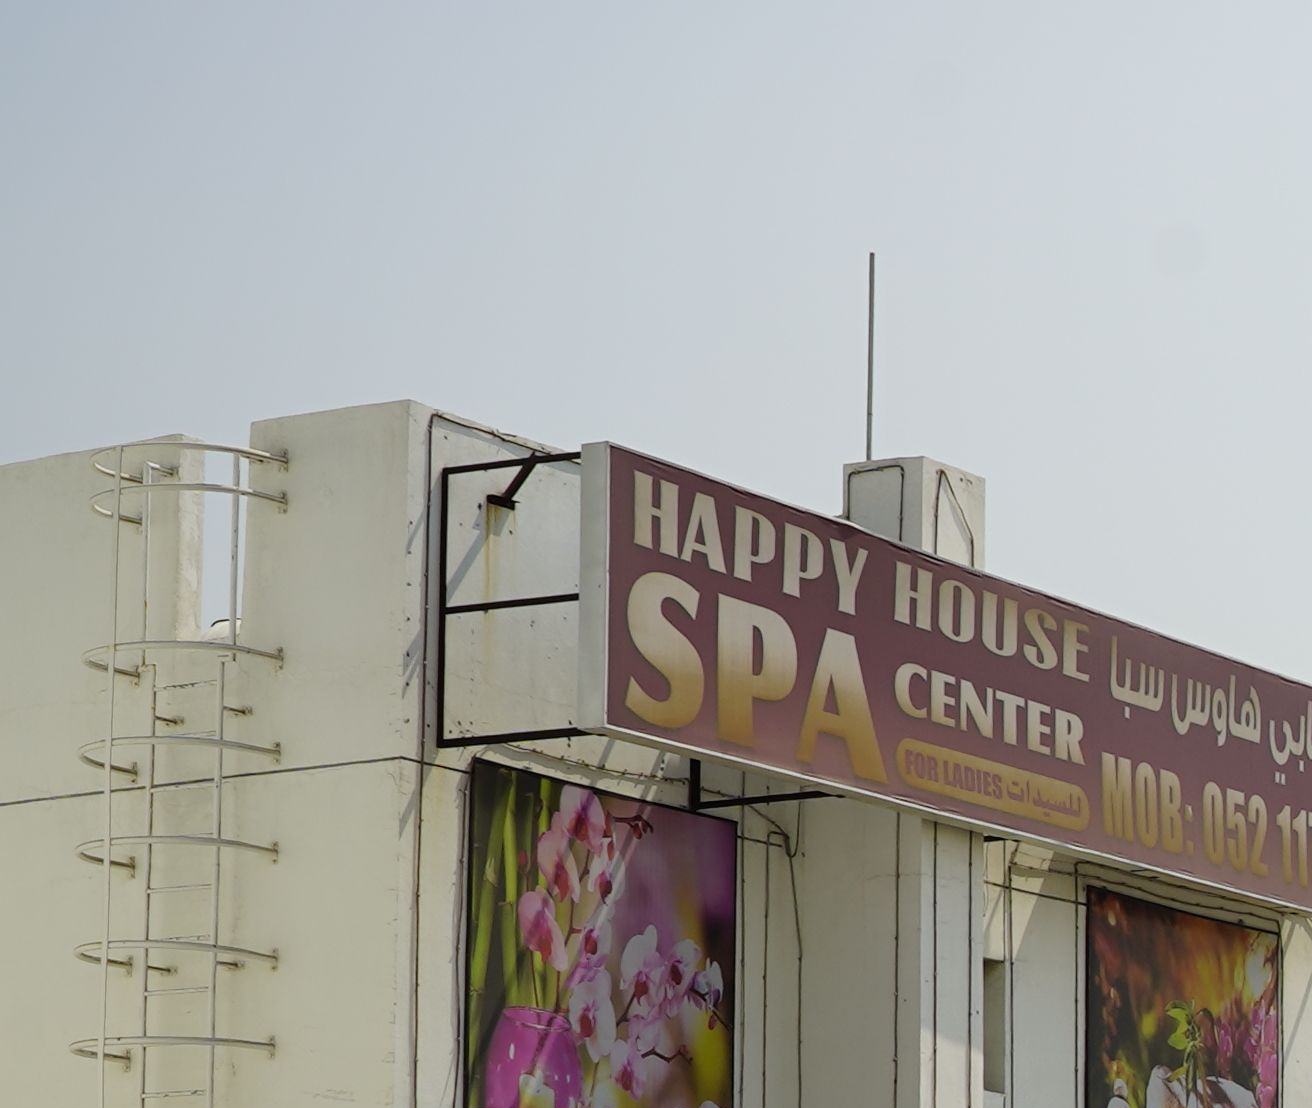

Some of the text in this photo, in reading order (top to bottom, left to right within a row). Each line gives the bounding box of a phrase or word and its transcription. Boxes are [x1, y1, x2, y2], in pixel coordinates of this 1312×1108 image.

[633, 469, 1091, 683] HAPPY HOUSE
[624, 571, 1086, 785] SPA CENTER
[1109, 635, 1165, 719] سبا
[1170, 674, 1262, 747] هاوس
[904, 748, 1003, 799] FOR LADIES
[1101, 751, 1195, 857] MOB:
[1203, 781, 1269, 878] 052
